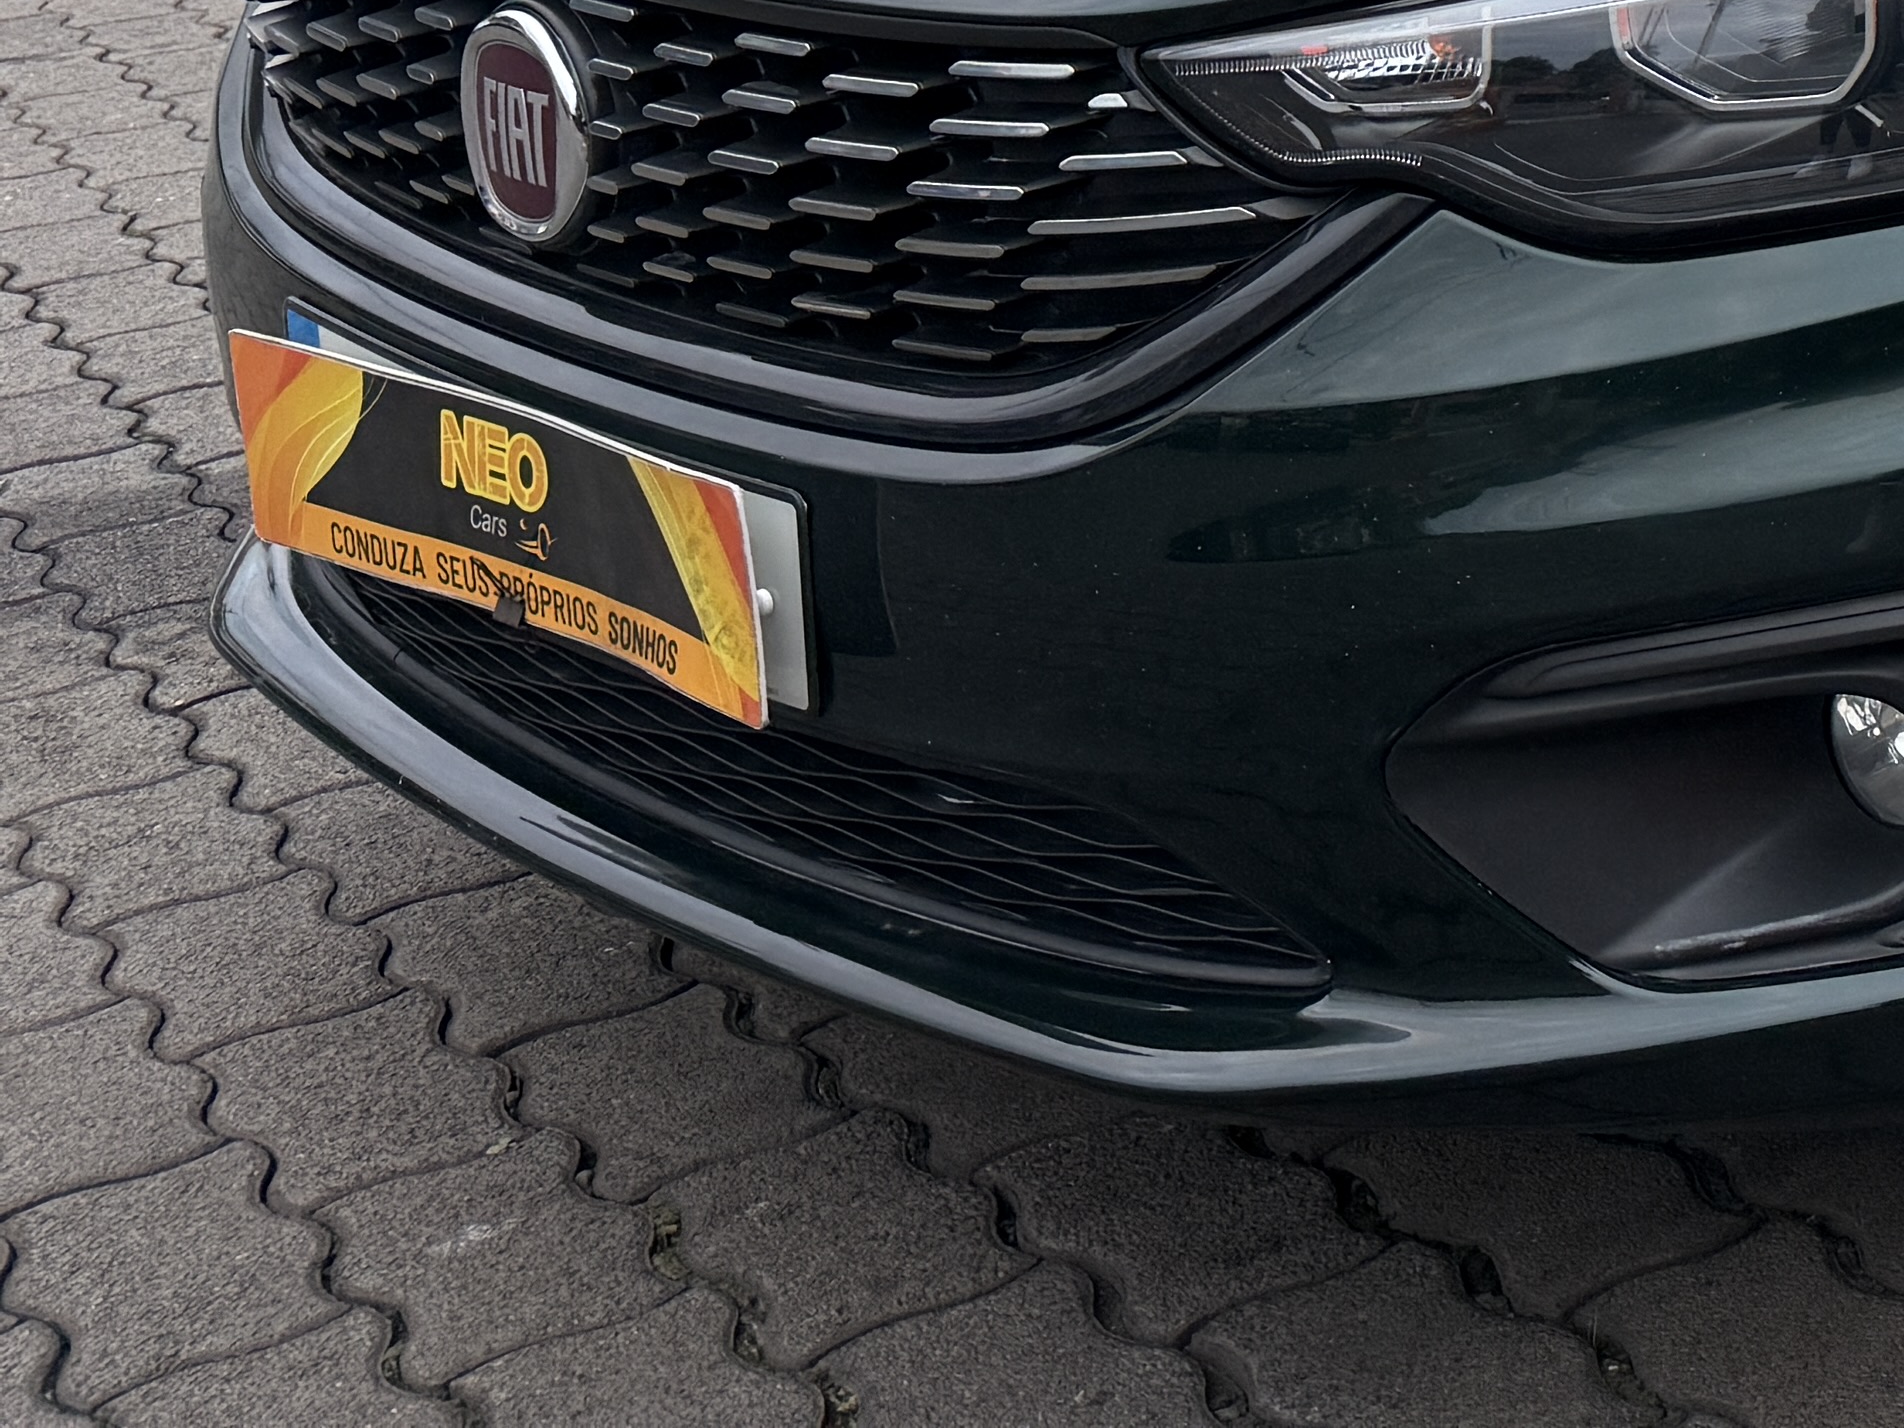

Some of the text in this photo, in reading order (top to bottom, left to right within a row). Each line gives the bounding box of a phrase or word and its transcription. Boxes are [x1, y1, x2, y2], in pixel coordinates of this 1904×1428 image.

[482, 75, 550, 188] FIAT
[439, 408, 549, 513] NEO
[469, 503, 508, 538] Cars
[330, 520, 427, 580] CONDUZA
[436, 550, 490, 599] SEUS
[607, 611, 679, 677] SONHOS
